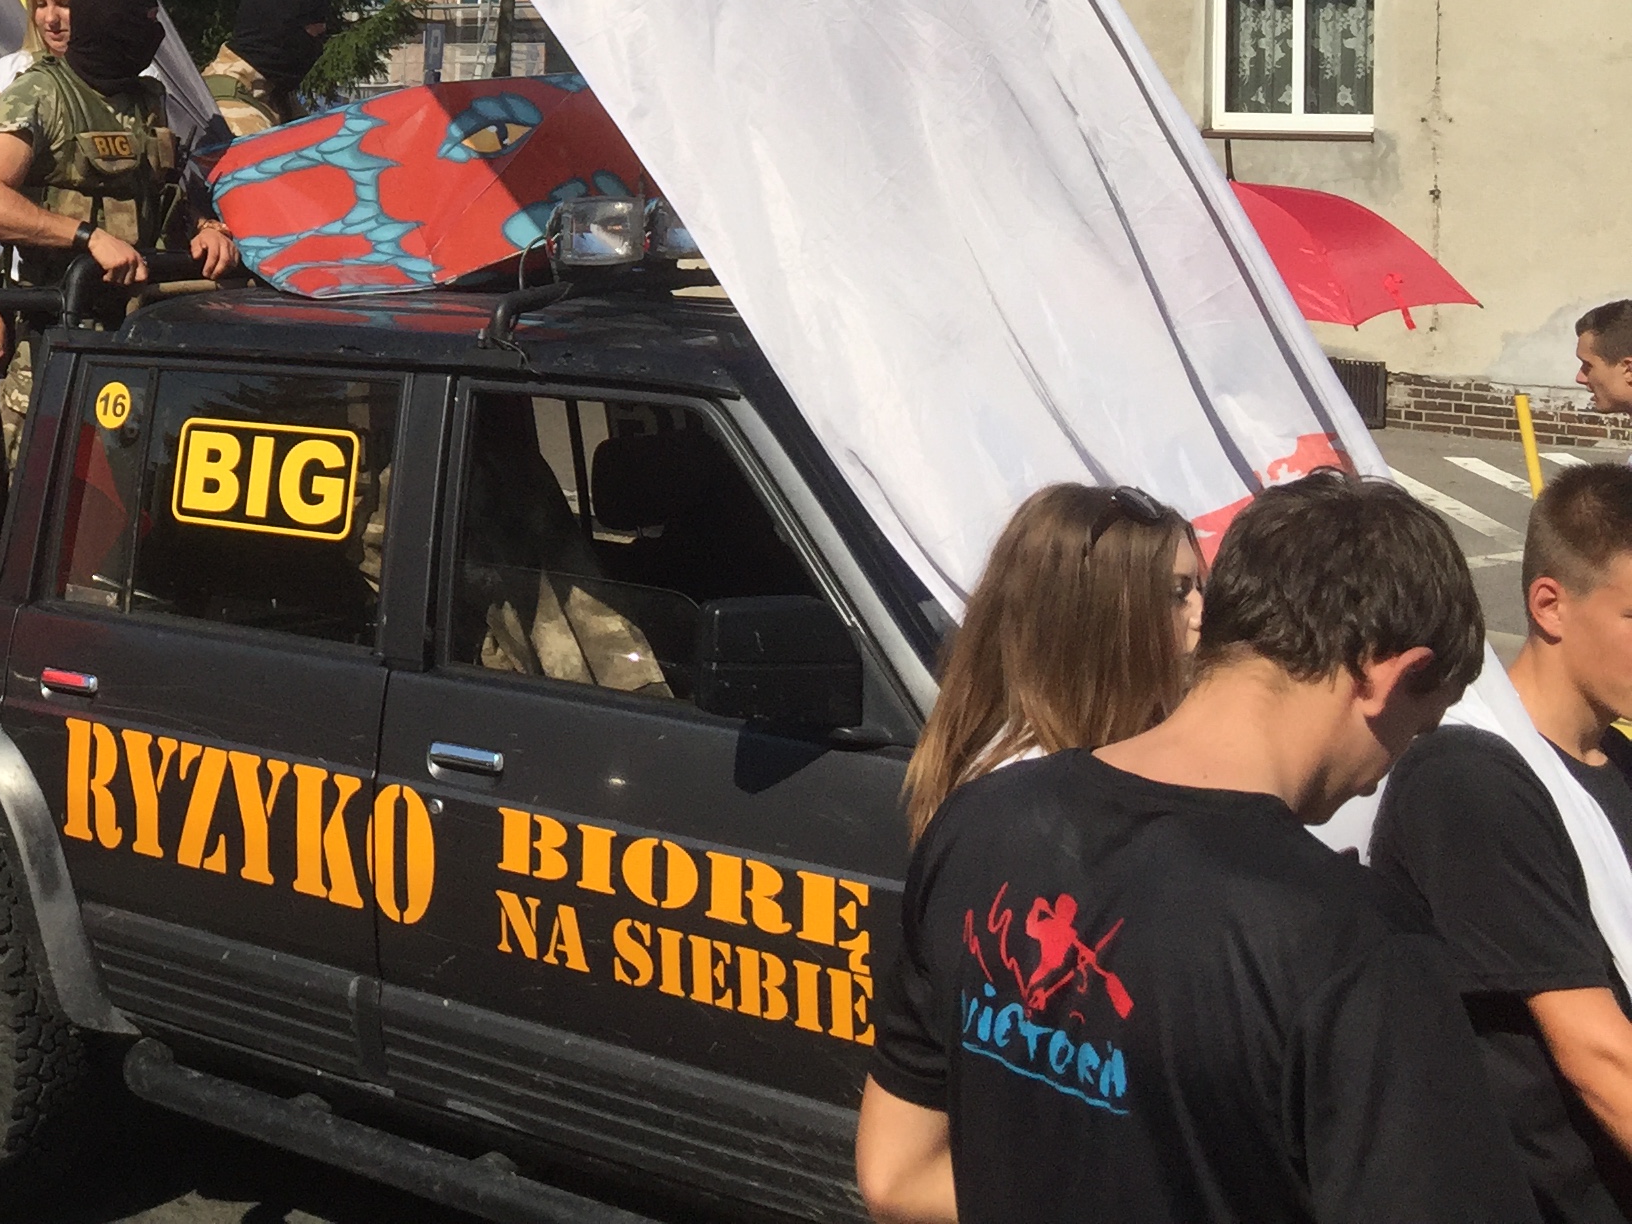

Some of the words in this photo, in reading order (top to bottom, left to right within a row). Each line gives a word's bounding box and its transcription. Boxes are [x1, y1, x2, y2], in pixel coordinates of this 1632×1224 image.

[93, 135, 131, 156] BIG
[99, 392, 126, 417] 16
[182, 430, 346, 525] BIG
[64, 717, 435, 924] RYZYKO
[497, 807, 870, 976] BIORĘ
[496, 890, 591, 973] NA
[613, 918, 876, 1047] SIEBIE
